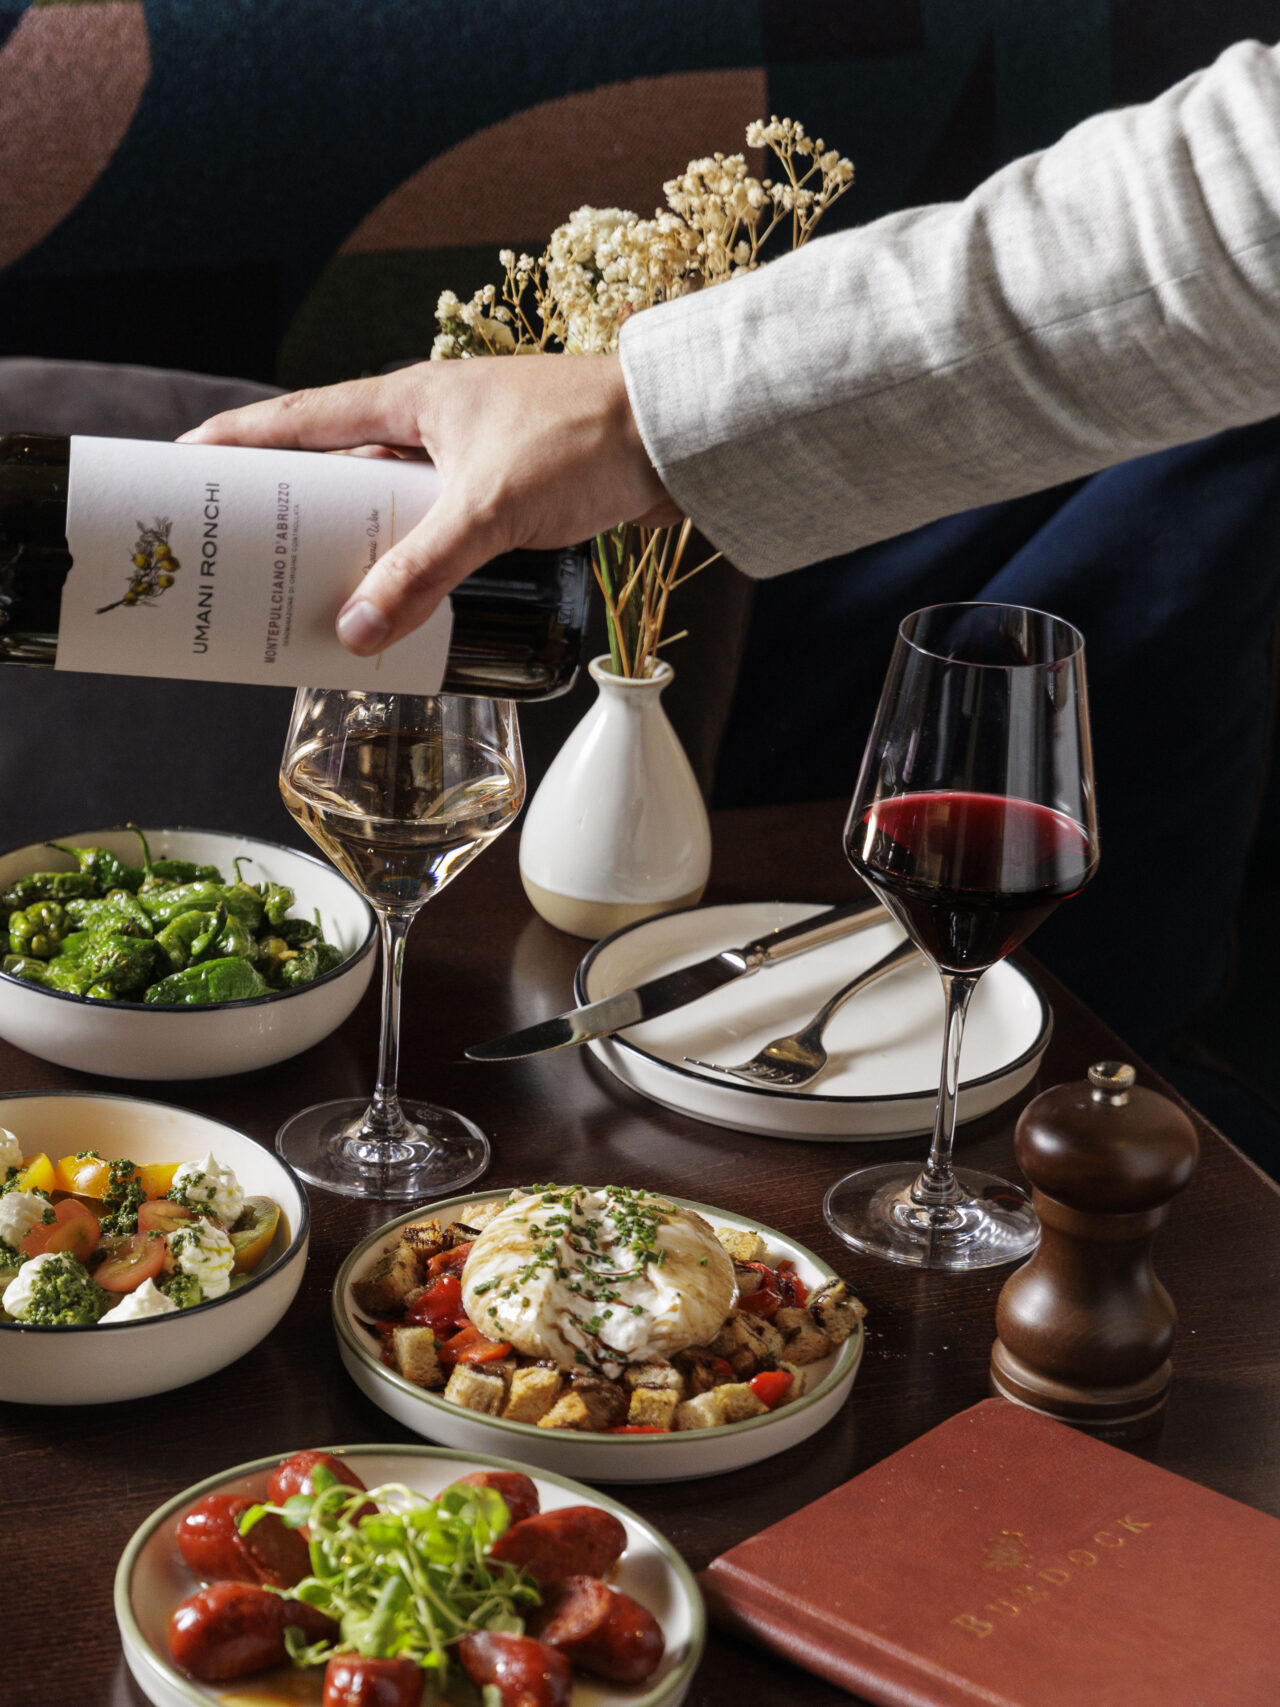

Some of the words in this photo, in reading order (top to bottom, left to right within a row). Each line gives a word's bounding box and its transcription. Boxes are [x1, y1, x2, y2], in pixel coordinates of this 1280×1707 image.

[200, 483, 220, 577] RONCHI
[264, 559, 286, 664] MONTEPULCIANO
[275, 482, 290, 555] D'ABRUZZO
[192, 585, 214, 654] UMANI
